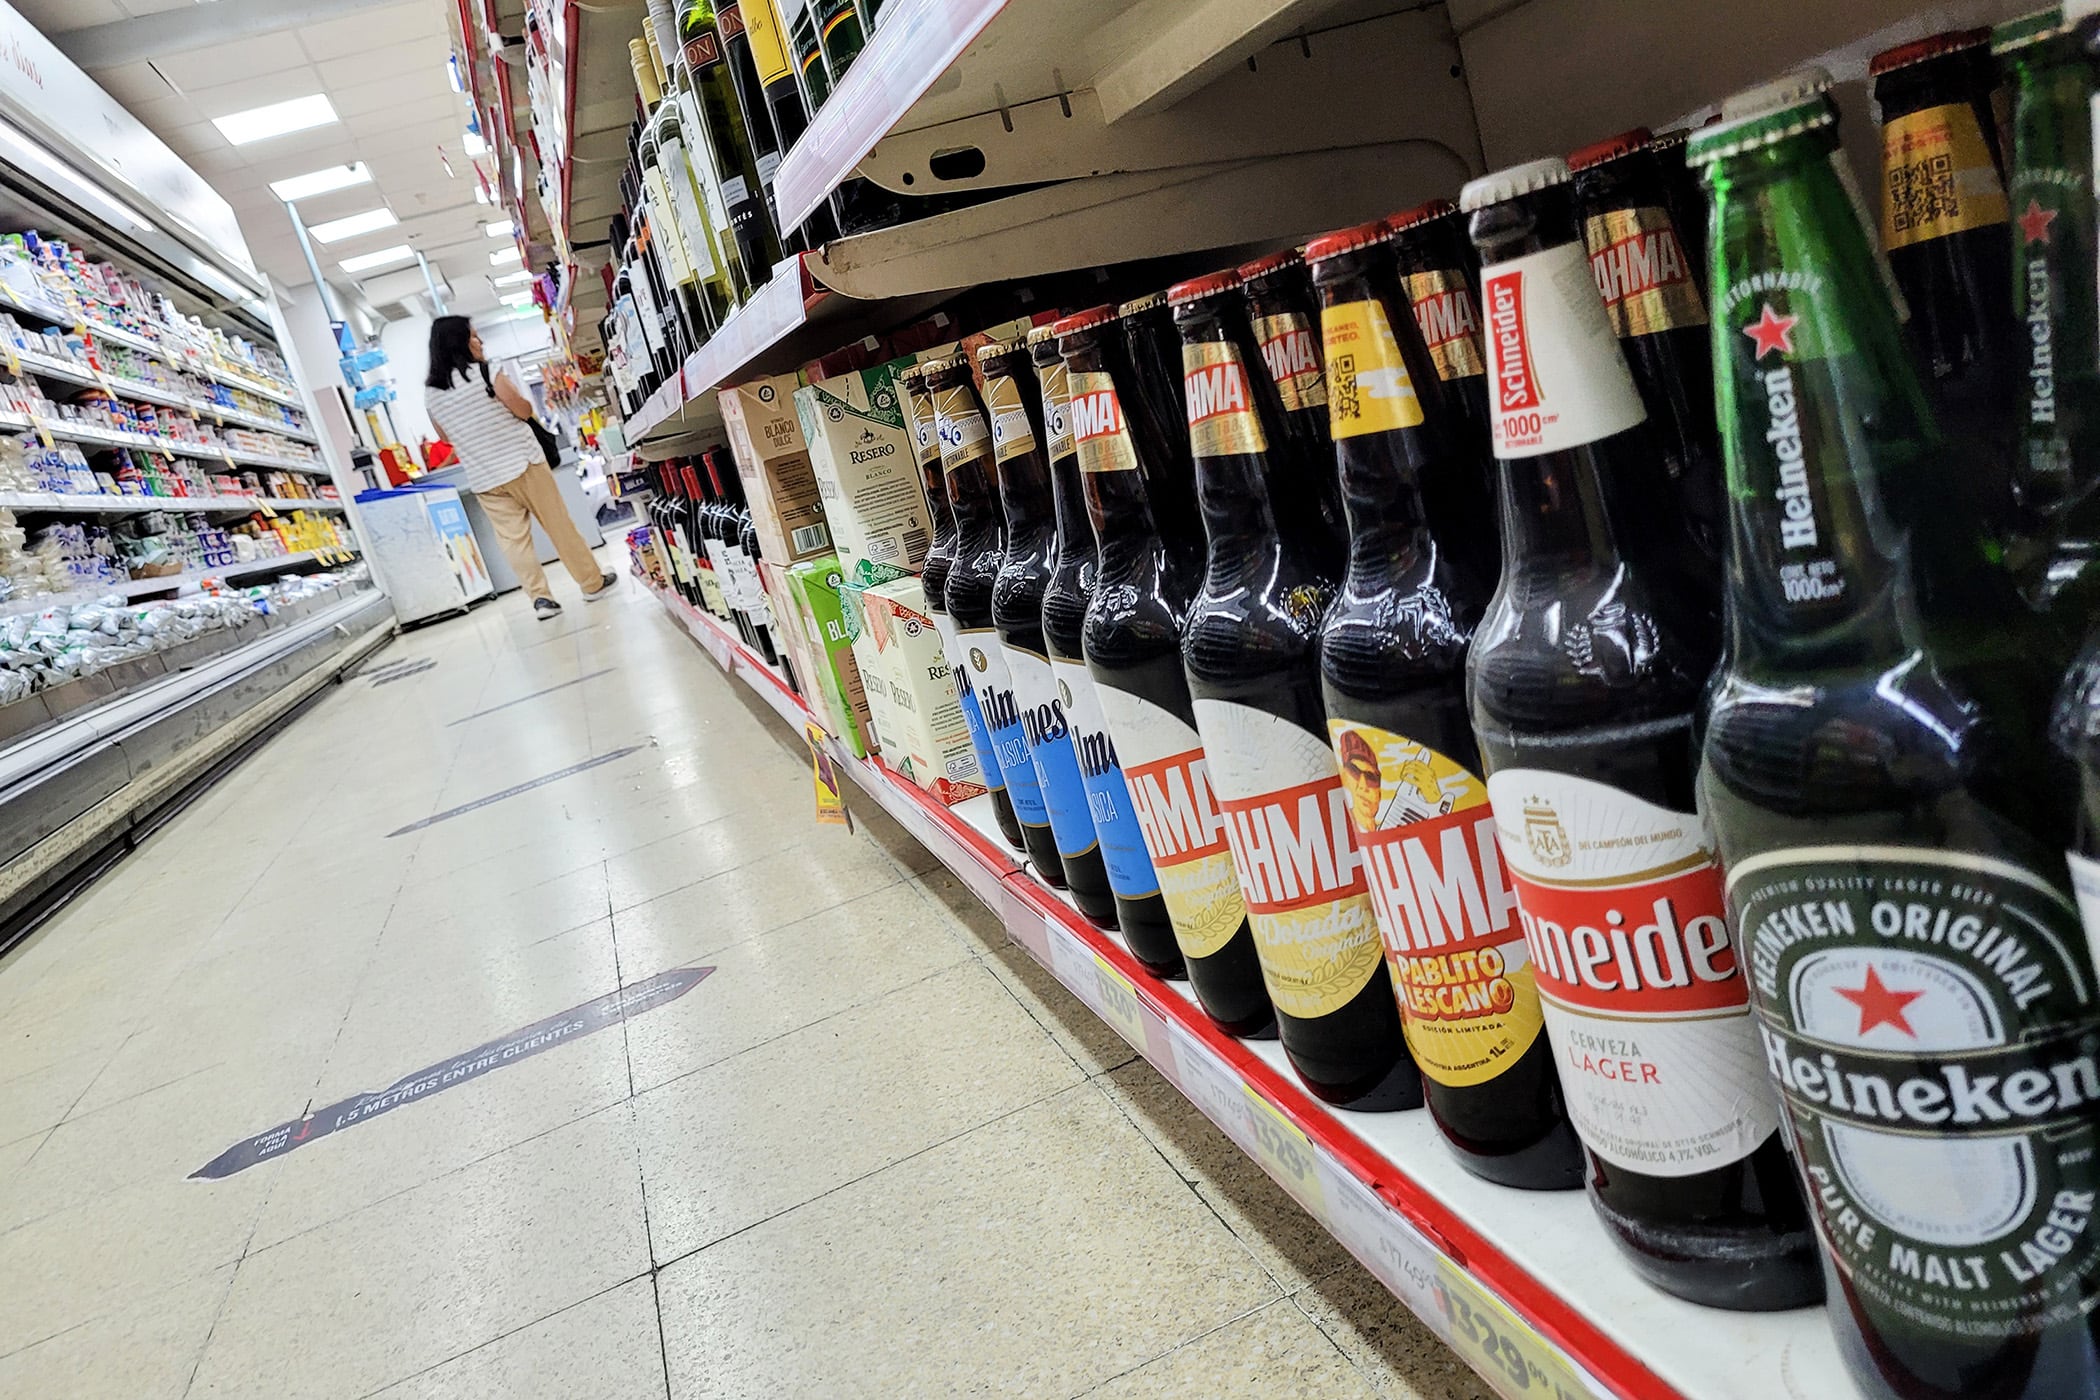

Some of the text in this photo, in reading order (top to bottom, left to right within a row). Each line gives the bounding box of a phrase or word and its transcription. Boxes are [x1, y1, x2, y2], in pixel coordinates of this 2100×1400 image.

[1495, 284, 1528, 407] Schneider
[764, 420, 795, 439] BLANCO
[773, 434, 793, 448] DULCE
[1503, 413, 1541, 439] 1000
[849, 444, 895, 465] RESERO
[1766, 367, 1818, 551] Heineken
[866, 468, 892, 480] BLANCO
[1593, 836, 1633, 849] CAMPEÓN
[1634, 835, 1648, 847] DEL
[1650, 828, 1683, 844] MUNDO
[1396, 947, 1504, 987] PABLITO
[1754, 901, 1857, 999] HEINEKEN
[1871, 901, 2052, 1010] ORIGINAL
[1405, 978, 1513, 1014] LESCANO
[1455, 1022, 1506, 1034] LIMITADA
[1570, 1029, 1642, 1057] CERVEZA
[363, 1079, 439, 1115] METROS
[442, 1055, 498, 1083] ENTRE
[503, 1020, 584, 1060] CLIENTES
[1568, 1048, 1662, 1085] LAGER
[1758, 1022, 2100, 1124] Heineken
[1695, 1143, 1721, 1157] VOL.
[1808, 1164, 1877, 1251] PURE
[1890, 1243, 1990, 1290] MALT
[2000, 1190, 2096, 1283] LAGER
